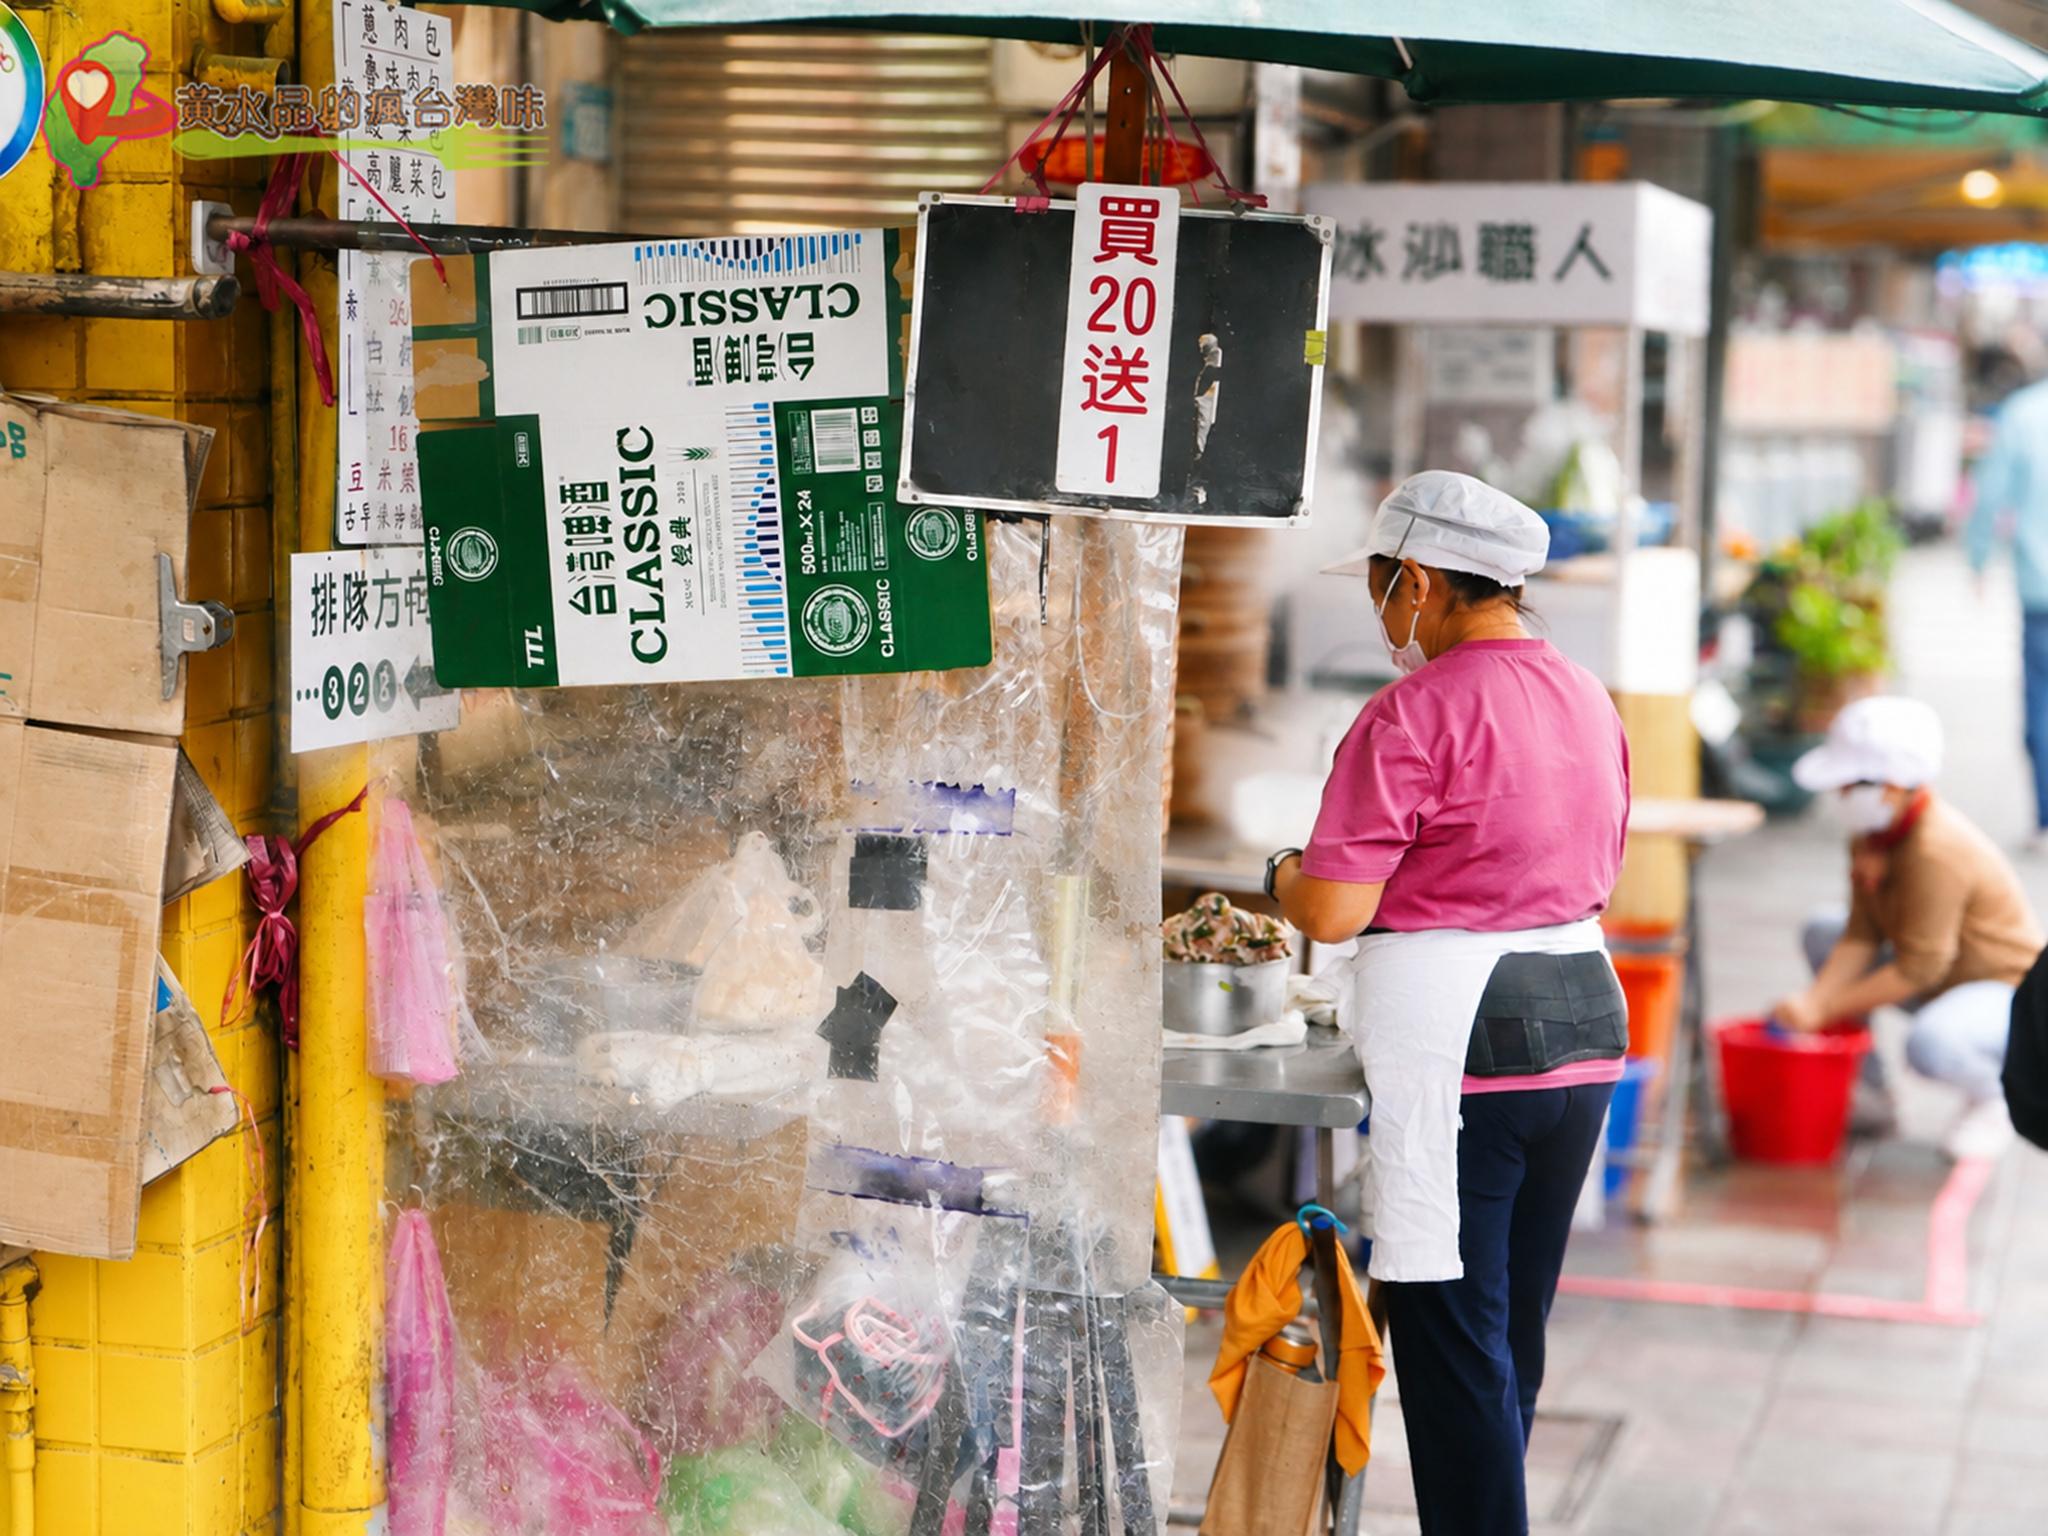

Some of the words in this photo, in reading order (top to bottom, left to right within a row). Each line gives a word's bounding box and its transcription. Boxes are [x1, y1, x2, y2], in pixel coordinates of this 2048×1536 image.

[1334, 219, 1613, 284] 冰沙職人
[642, 283, 860, 329] CLASSIC
[616, 425, 668, 664] CLASSIC
[524, 625, 546, 669] TTL
